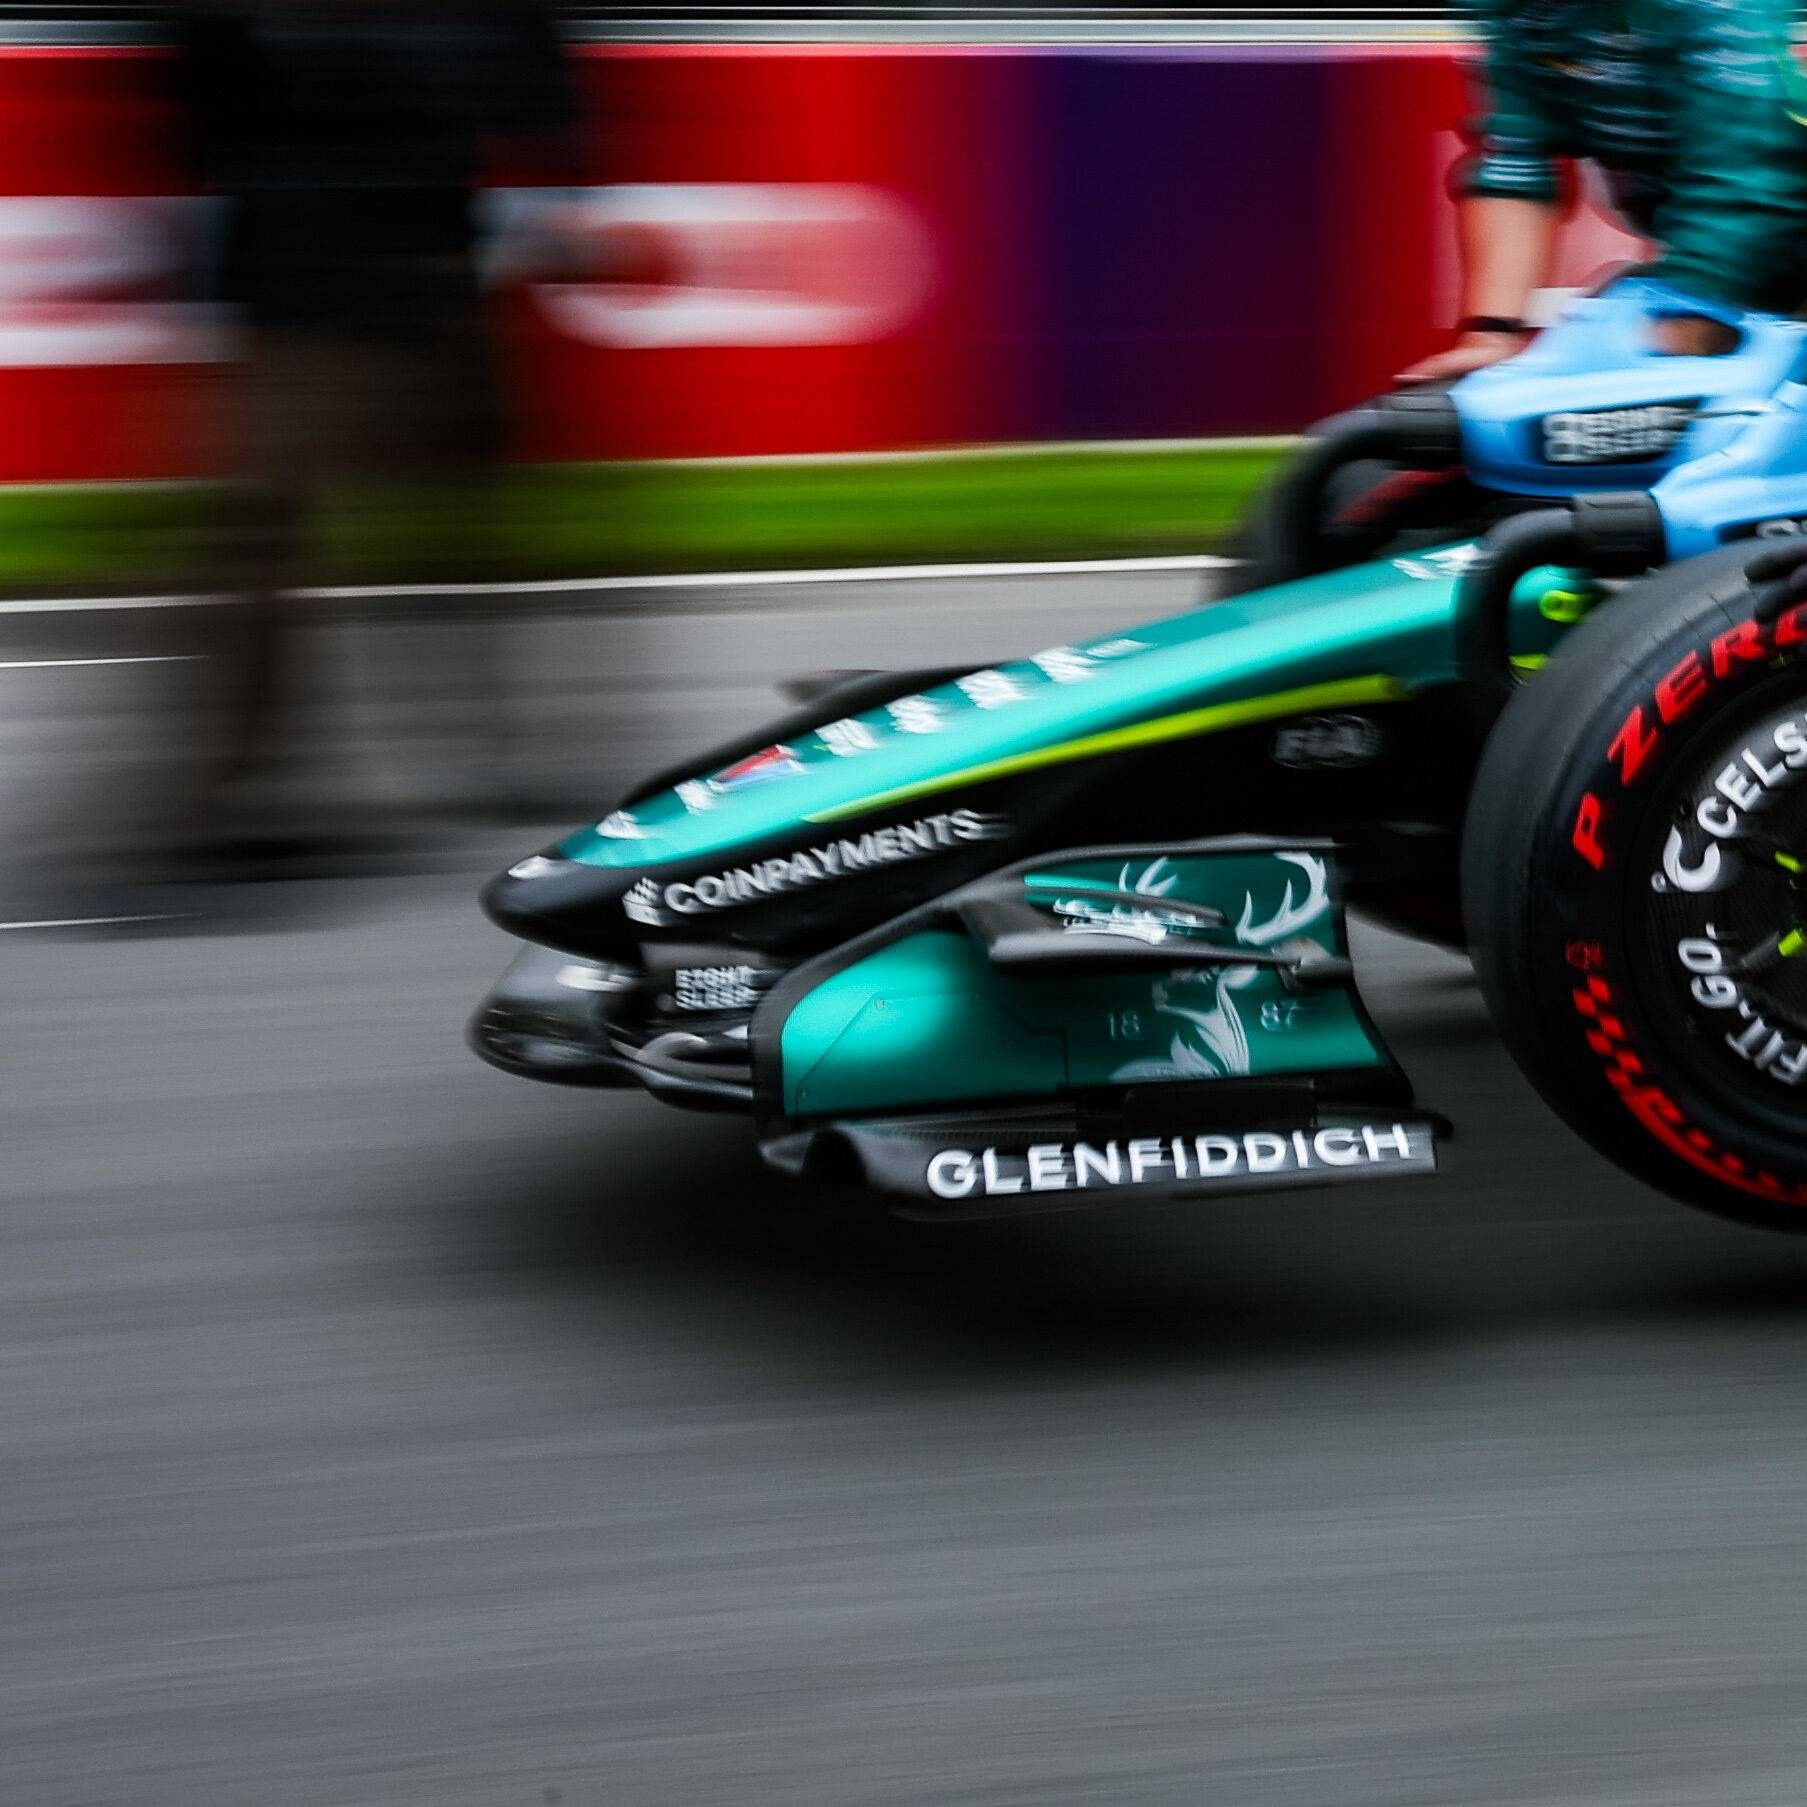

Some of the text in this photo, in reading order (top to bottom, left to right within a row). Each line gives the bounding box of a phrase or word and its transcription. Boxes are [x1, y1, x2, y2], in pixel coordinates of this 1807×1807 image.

[664, 808, 988, 914] COINPAYMENTS
[1570, 792, 1606, 871] P
[1106, 999, 1299, 1042] 18 87
[926, 1123, 1412, 1198] GLENFIDDICH
